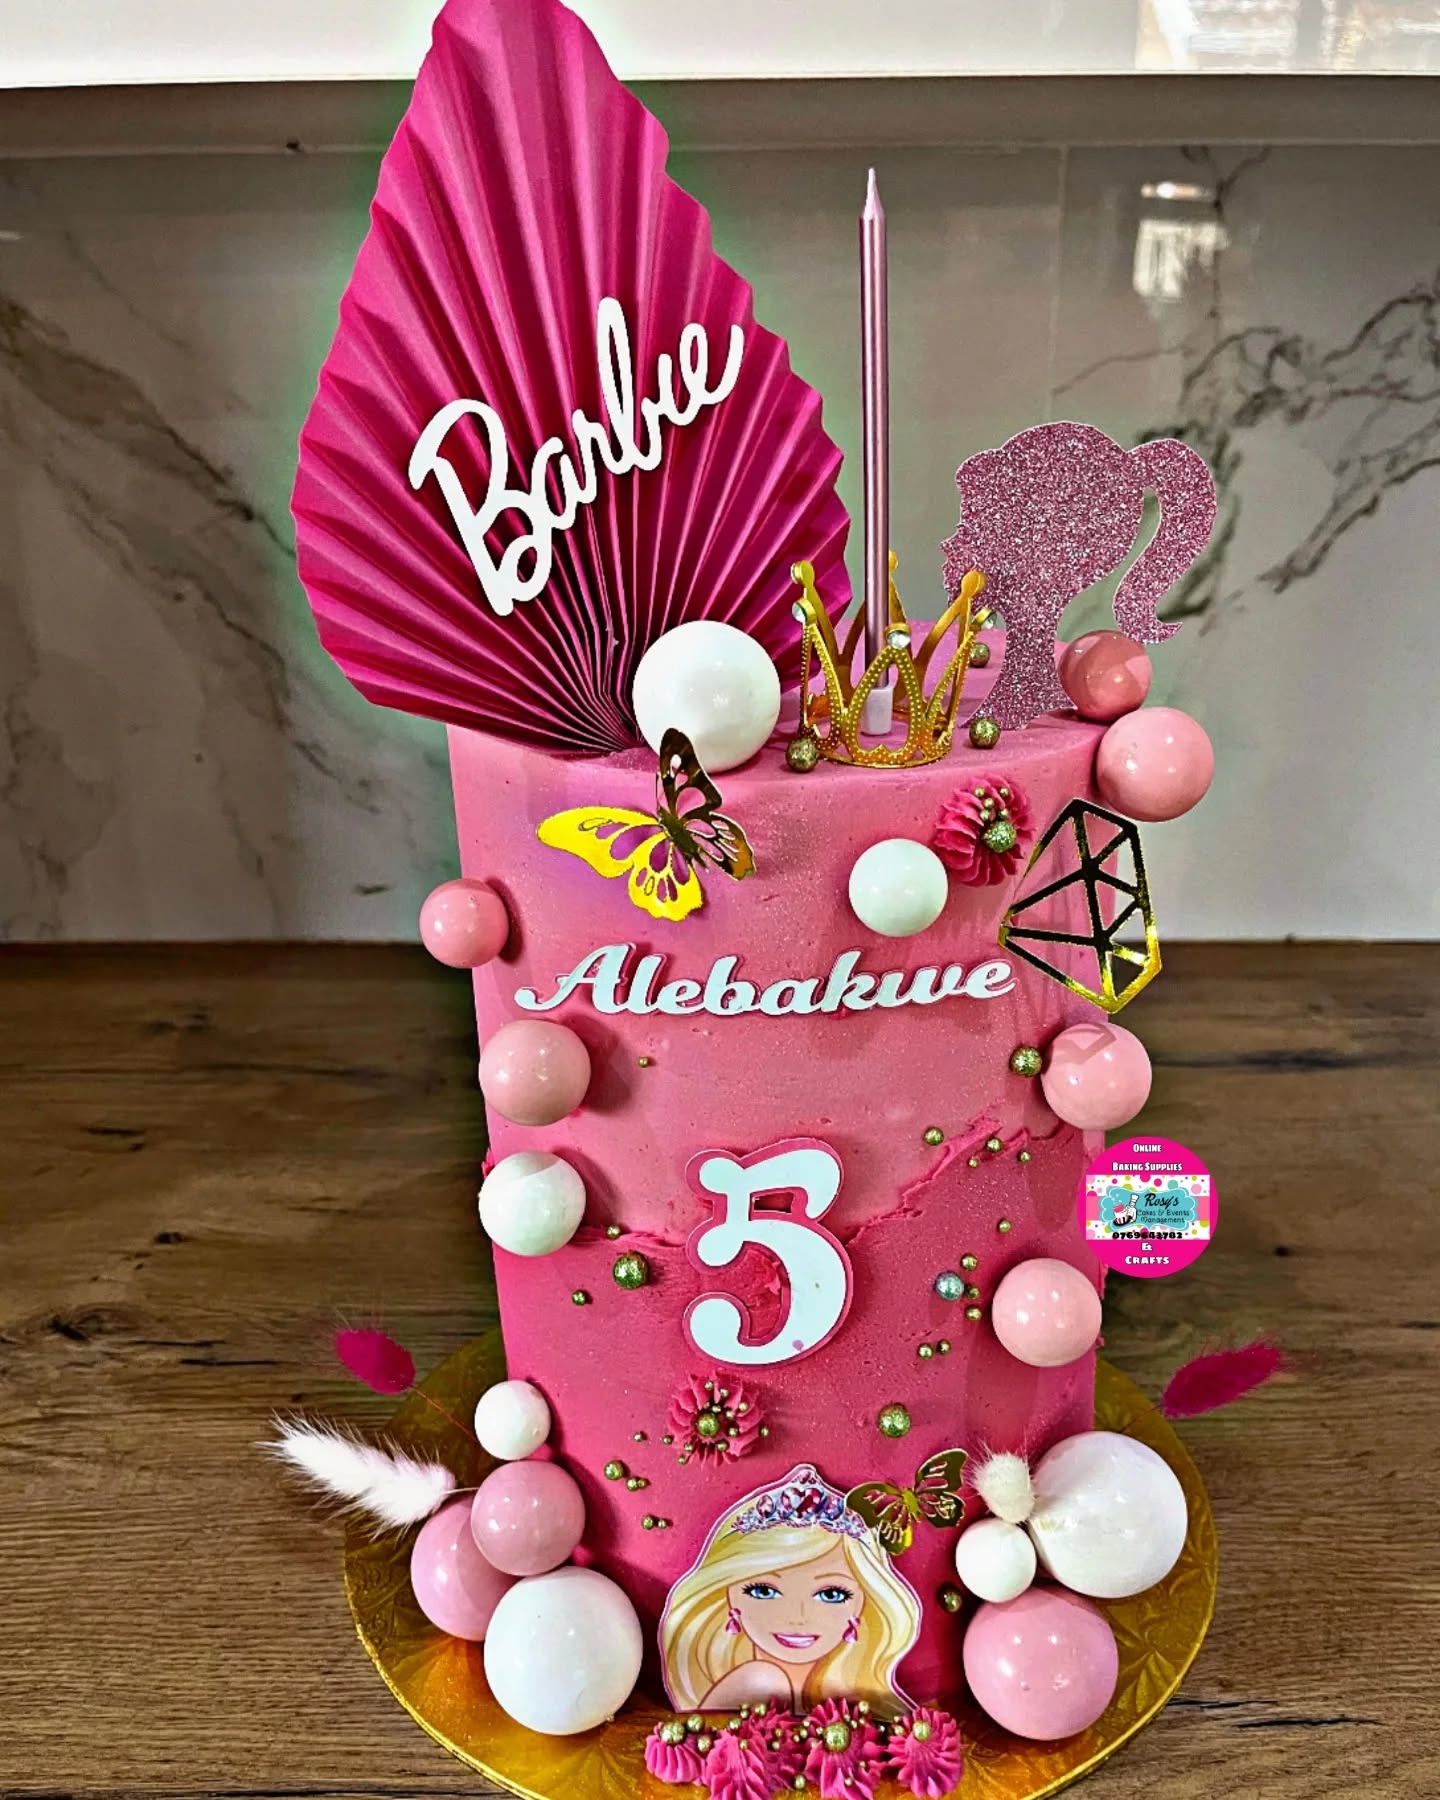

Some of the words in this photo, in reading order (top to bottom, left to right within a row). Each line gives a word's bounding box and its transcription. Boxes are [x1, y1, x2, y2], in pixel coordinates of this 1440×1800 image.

[408, 297, 745, 617] Barbie
[513, 942, 1017, 1016] Alebakwe
[688, 1144, 849, 1367] 5
